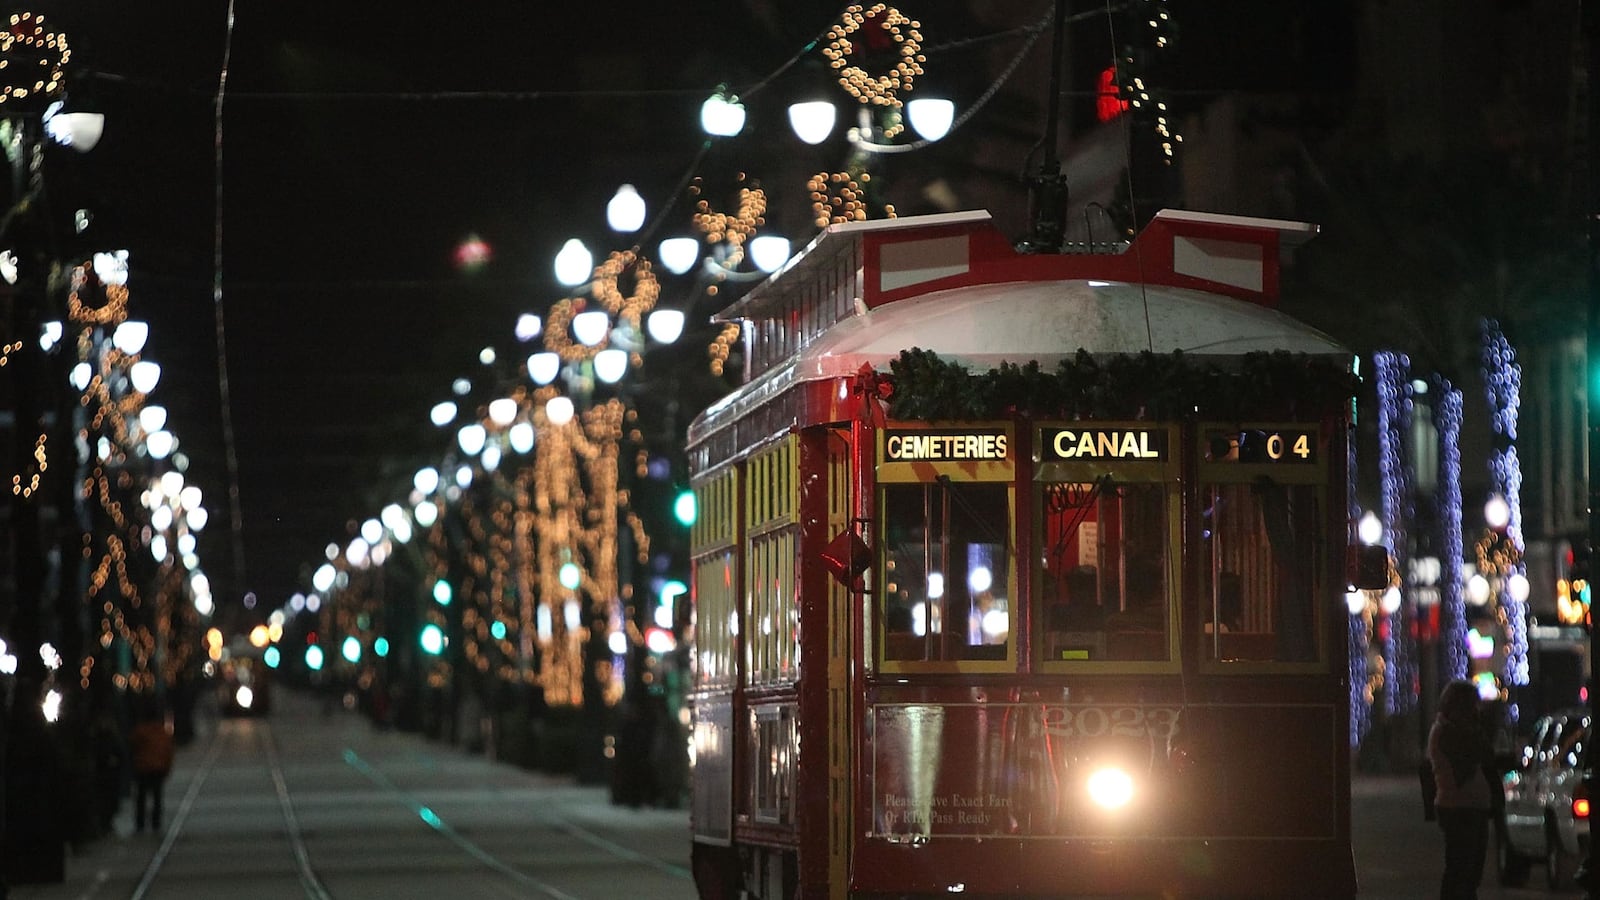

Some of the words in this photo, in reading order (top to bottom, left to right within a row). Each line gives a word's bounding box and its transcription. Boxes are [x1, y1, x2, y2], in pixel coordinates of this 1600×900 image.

[887, 435, 1007, 459] CEMETERIES
[1053, 431, 1159, 458] CANAL
[1041, 707, 1181, 737] 2023
[885, 793, 917, 807] Please
[953, 793, 985, 807] Exact
[989, 793, 1012, 807] Fare
[885, 810, 899, 824] Or
[931, 810, 954, 824] Pass
[958, 810, 992, 825] Ready
